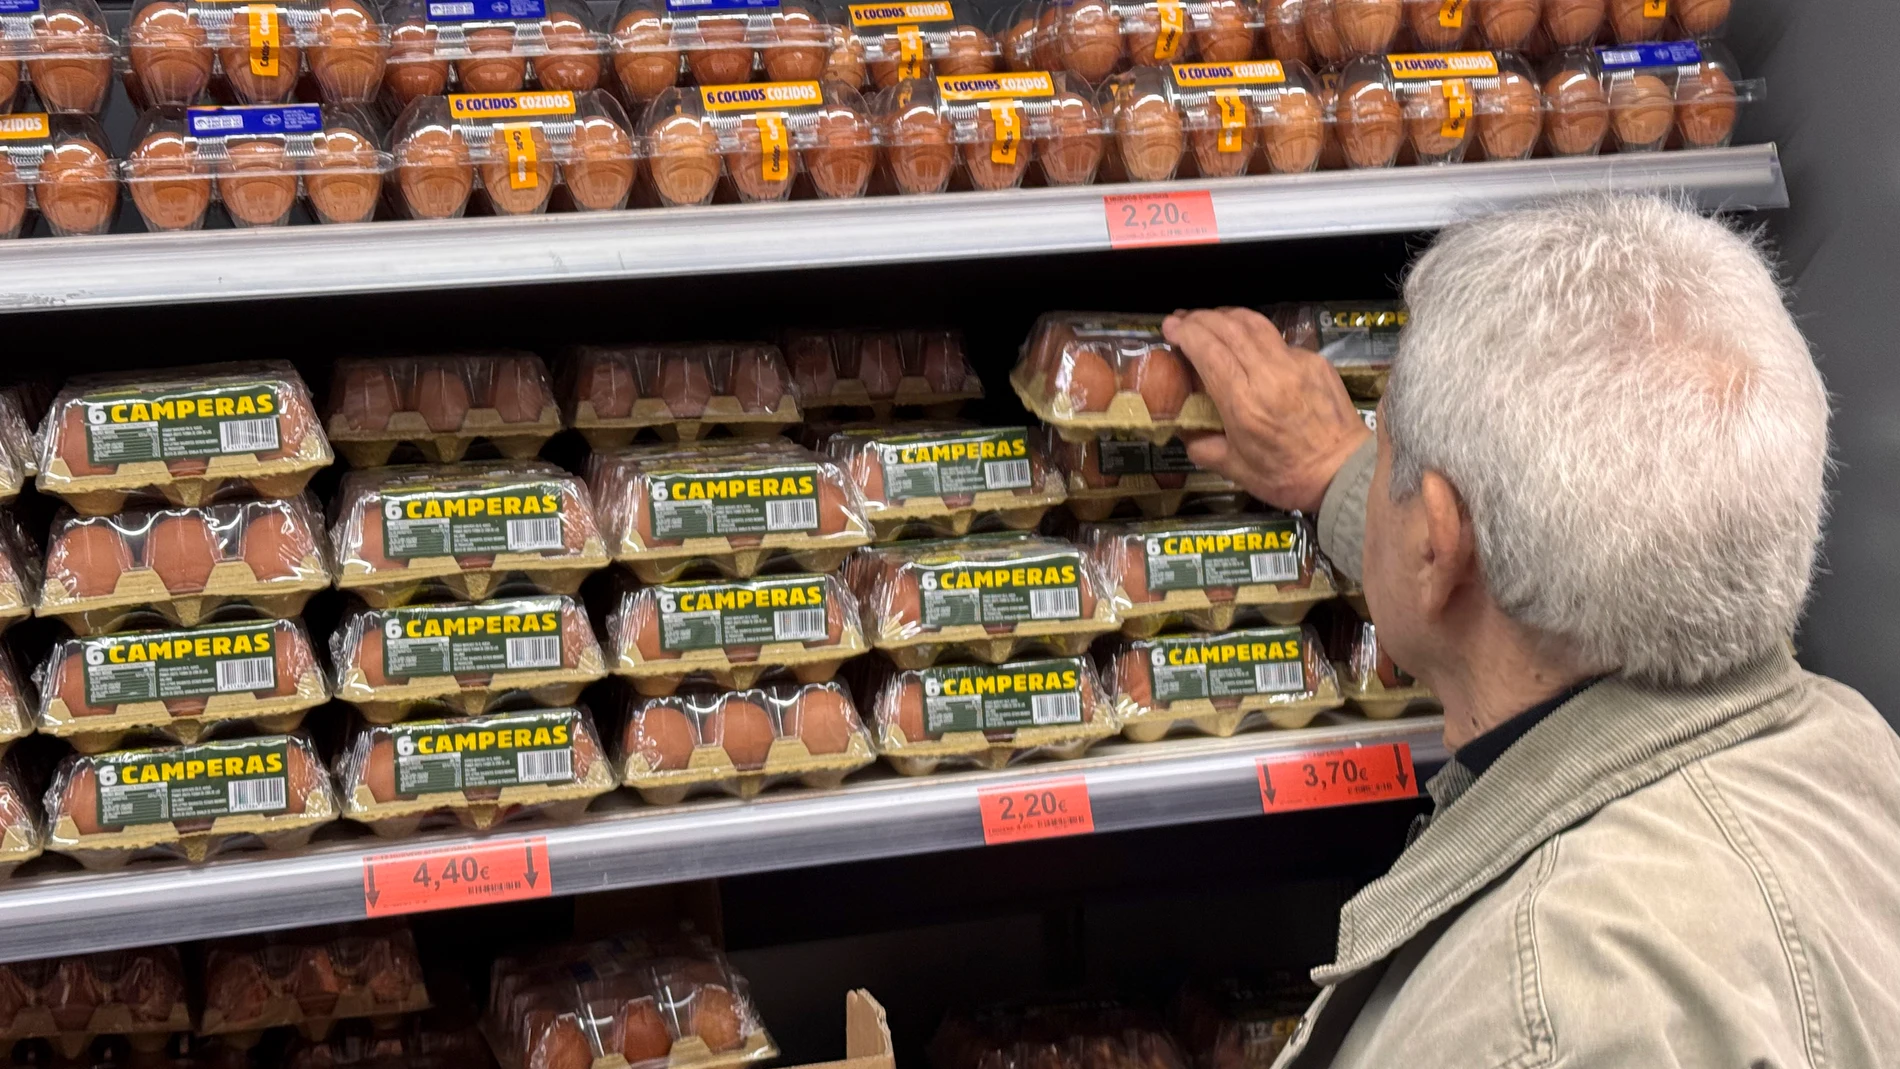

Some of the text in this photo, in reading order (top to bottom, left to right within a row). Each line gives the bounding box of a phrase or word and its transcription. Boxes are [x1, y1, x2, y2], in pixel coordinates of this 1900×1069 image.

[854, 3, 949, 20] 6 COCIDOS COZIDOS
[1178, 61, 1281, 80] 6 COCIDOS COZIDOS
[1405, 57, 1449, 71] COCIDOS
[1449, 54, 1493, 69] COZIDOS
[707, 85, 817, 104] 6 COCIDOS COZIDOS
[944, 75, 1049, 92] 6 COCIDOS COZIDOS
[456, 93, 570, 112] 6 COCIDOS COZIDOS
[1122, 202, 1190, 230] 2,20€
[1320, 311, 1333, 327] 6
[87, 393, 274, 425] 6 CAMPERAS
[884, 439, 1026, 465] 6 CAMPERAS
[652, 475, 814, 501] 6 CAMPERAS
[384, 494, 558, 520] 6 CAMPERAS
[1146, 531, 1292, 556] 6 CAMPERAS
[921, 565, 1076, 591] 6 CAMPERAS
[660, 585, 822, 613] 6 CAMPERAS
[385, 612, 558, 639] 6 CAMPERAS
[85, 632, 271, 666] 6 CAMPERAS
[1151, 640, 1299, 667] 6 CAMPERAS
[925, 670, 1077, 697] 6 CAMPERAS
[396, 725, 569, 756] 6 CAMPERAS
[99, 752, 283, 786] 6 CAMPERAS
[1302, 759, 1369, 790] 3,70€
[999, 791, 1068, 823] 2,20€
[413, 857, 490, 891] 4,40€
